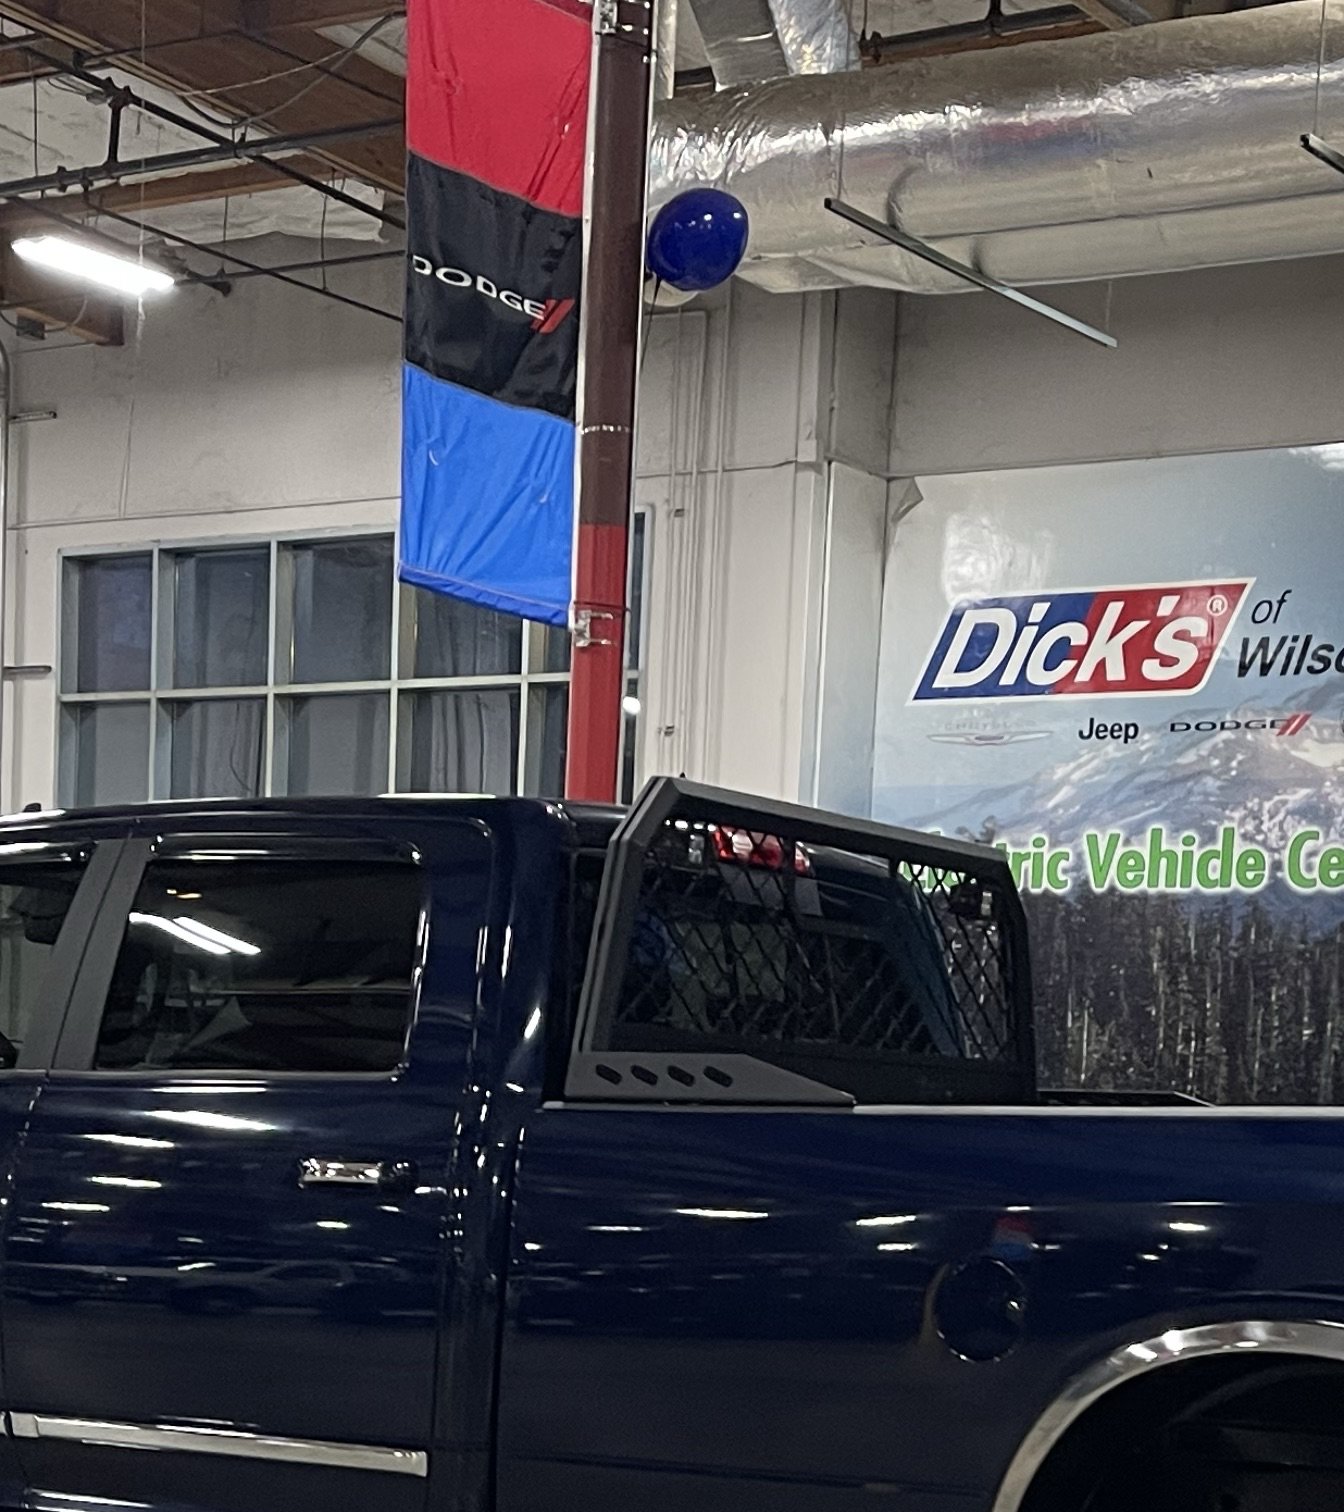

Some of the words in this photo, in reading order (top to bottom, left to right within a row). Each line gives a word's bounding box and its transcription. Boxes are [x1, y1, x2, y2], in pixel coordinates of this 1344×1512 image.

[412, 254, 546, 321] DODGE
[1250, 589, 1293, 624] of
[1078, 717, 1140, 744] Jeep
[1169, 718, 1288, 733] DODGE
[1086, 827, 1267, 889] Vehicle
